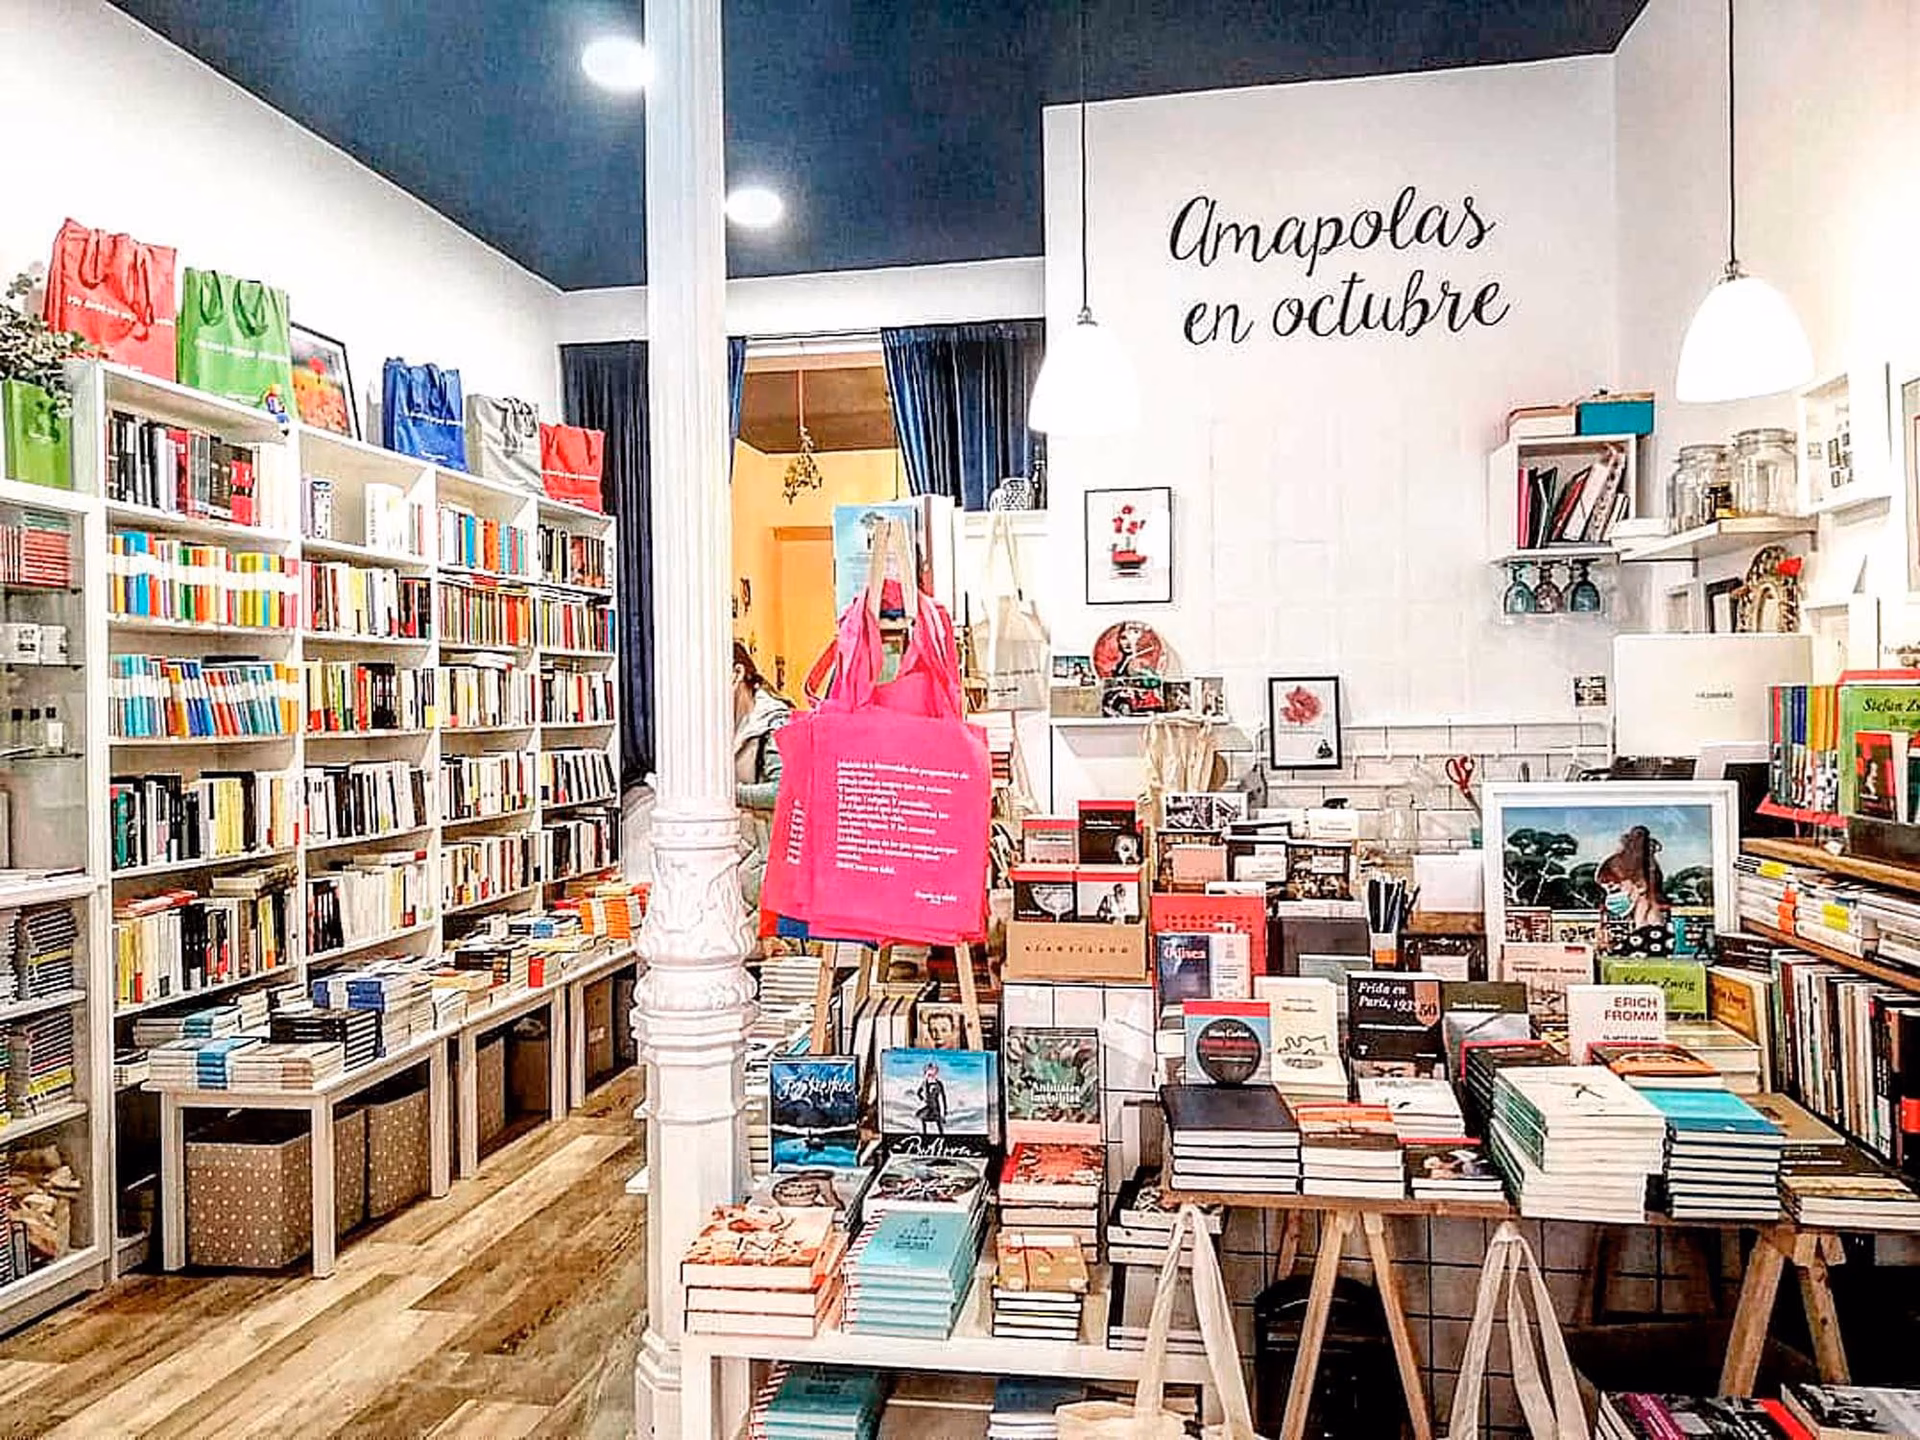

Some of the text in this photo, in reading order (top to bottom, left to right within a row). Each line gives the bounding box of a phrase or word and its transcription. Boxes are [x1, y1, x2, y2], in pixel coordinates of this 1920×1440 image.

[1169, 186, 1496, 278] Amapolas
[1183, 268, 1511, 346] en octubre
[1358, 982, 1407, 995] Frida en
[1661, 977, 1696, 991] Zweig
[1614, 997, 1658, 1008] ERICH
[1419, 1004, 1437, 1017] 50
[1604, 1010, 1658, 1021] FROMM
